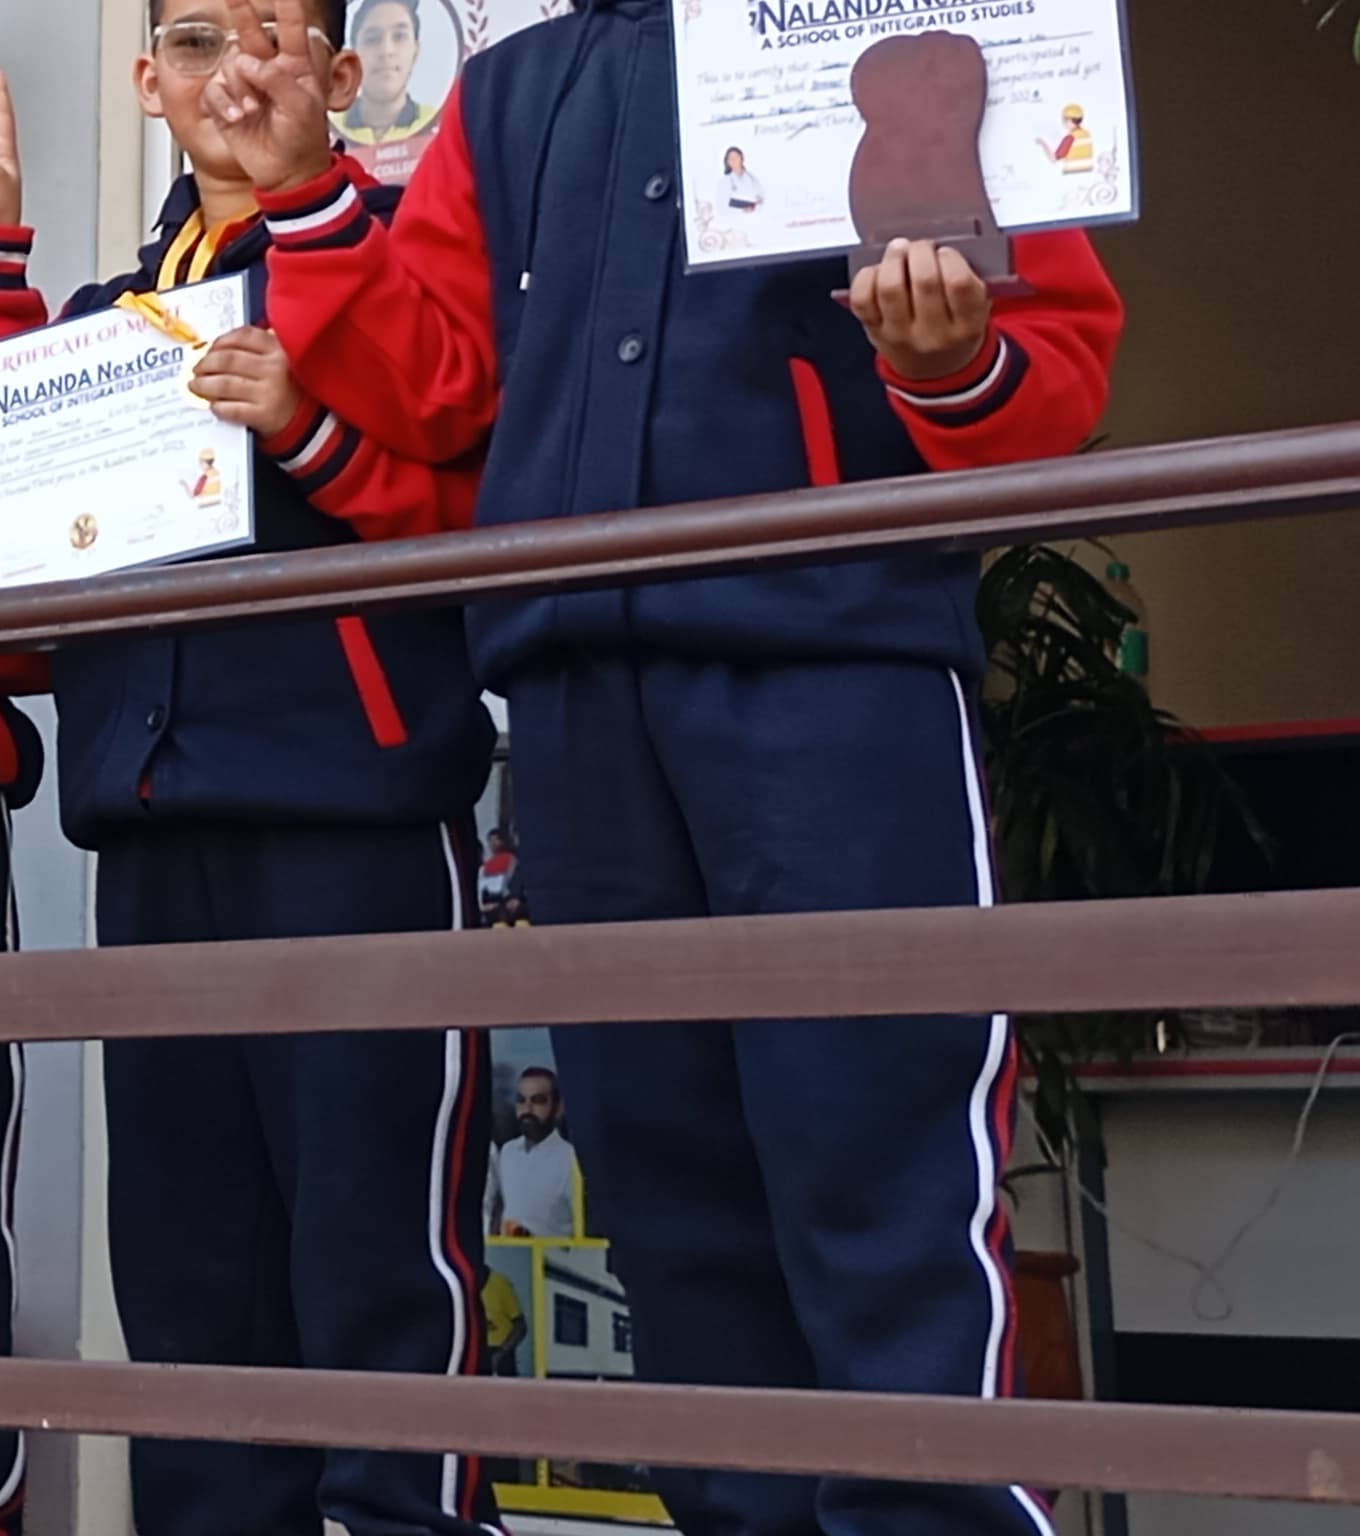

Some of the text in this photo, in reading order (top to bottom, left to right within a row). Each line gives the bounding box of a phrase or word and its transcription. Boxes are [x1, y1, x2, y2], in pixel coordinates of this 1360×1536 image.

[761, 0, 1036, 50] A SCHOOL OF INTEGRATED STUDIES
[97, 345, 184, 383] NextGen
